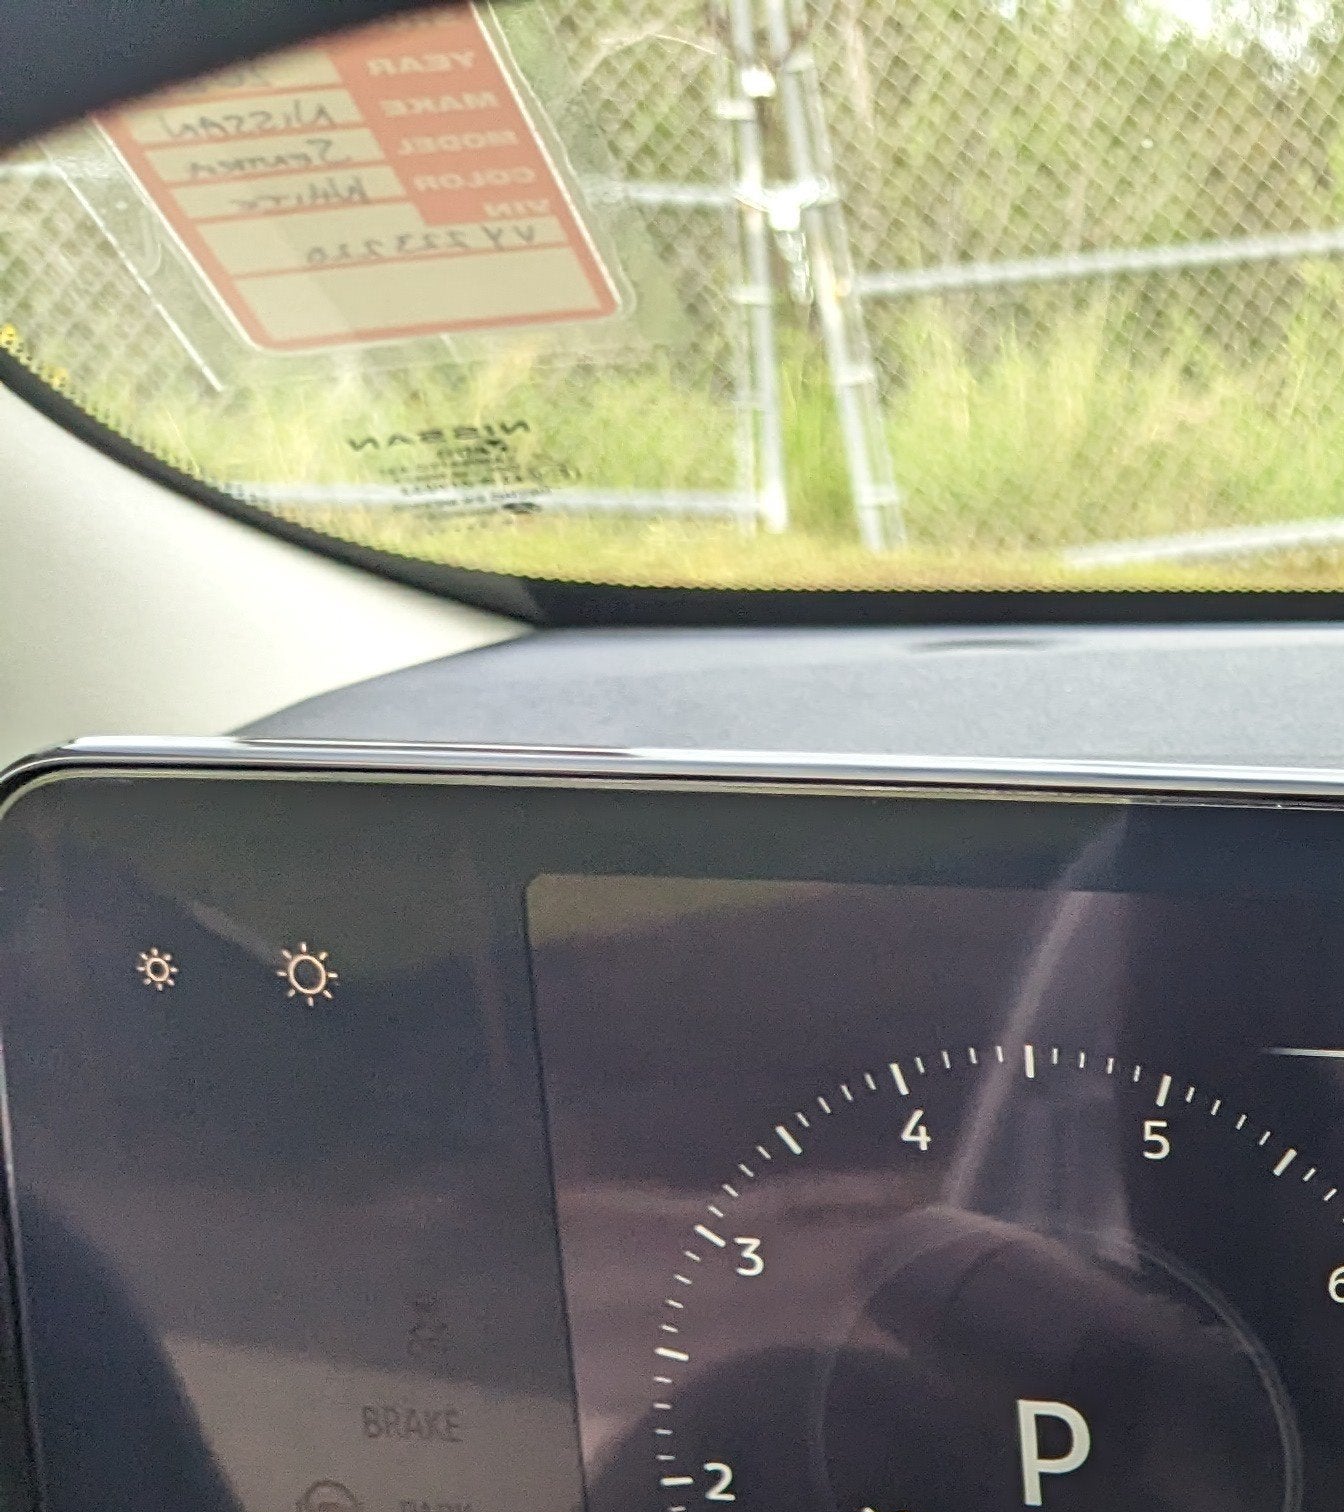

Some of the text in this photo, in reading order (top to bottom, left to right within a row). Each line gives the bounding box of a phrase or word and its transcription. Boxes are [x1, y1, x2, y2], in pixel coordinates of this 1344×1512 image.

[899, 1110, 931, 1151] 4
[1143, 1120, 1170, 1159] 5
[735, 1237, 764, 1276] 3
[361, 1404, 465, 1445] BRAKE
[1016, 1398, 1092, 1509] P
[703, 1462, 736, 1501] 2
